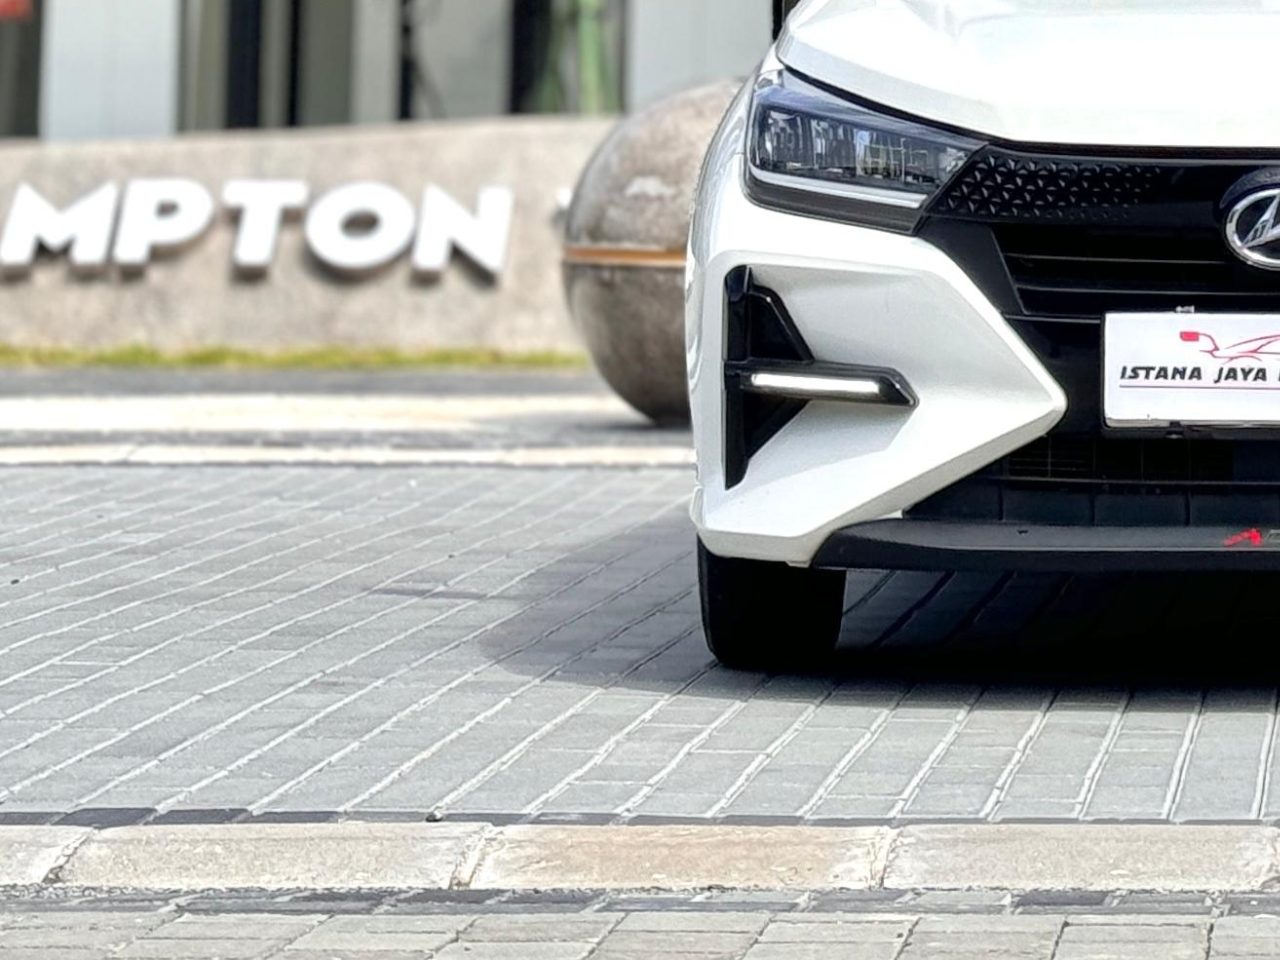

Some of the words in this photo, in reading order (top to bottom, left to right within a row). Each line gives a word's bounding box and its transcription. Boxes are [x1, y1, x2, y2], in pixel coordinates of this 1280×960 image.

[0, 178, 514, 278] MPTON
[1119, 365, 1203, 381] ISTANA
[1213, 366, 1268, 383] JAYA
